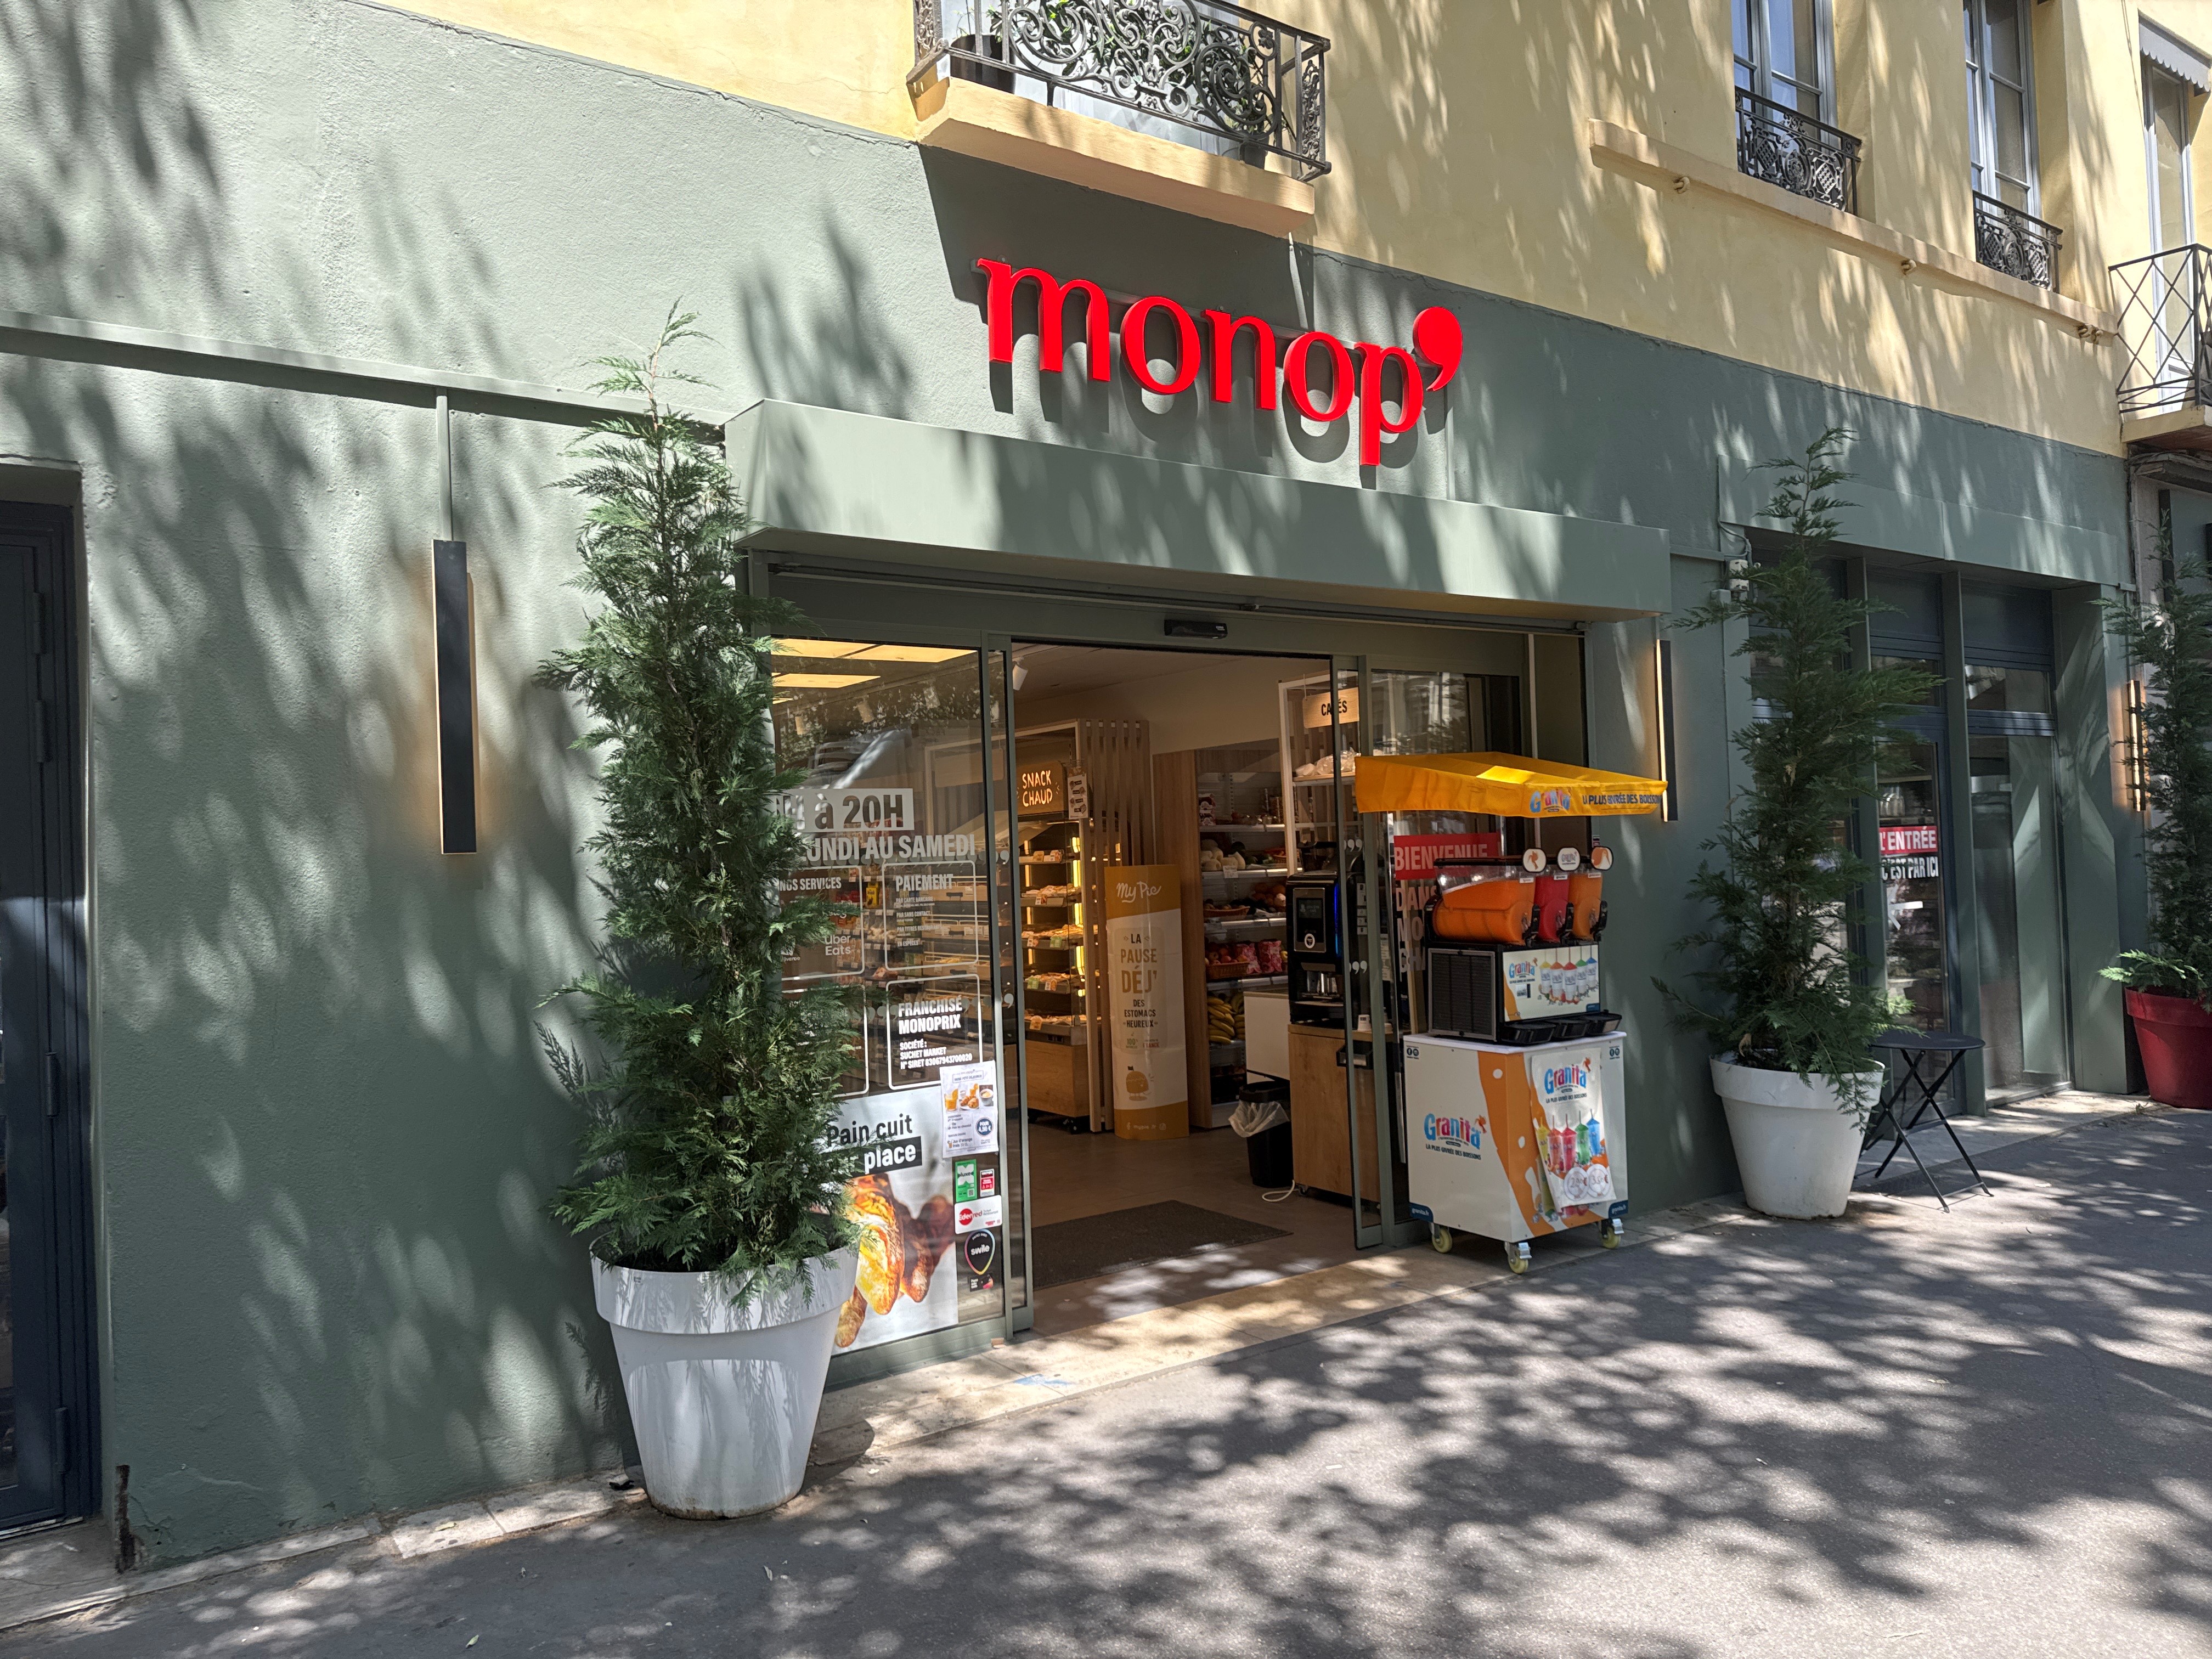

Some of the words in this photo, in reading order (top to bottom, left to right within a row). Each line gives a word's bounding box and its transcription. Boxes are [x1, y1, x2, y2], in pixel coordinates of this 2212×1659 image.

[977, 258, 1463, 466] monop'
[1321, 698, 1347, 716] CAÉS
[1022, 770, 1052, 789] SNACK
[1023, 788, 1053, 807] CHAUD
[1588, 794, 1607, 805] PLUS
[1626, 794, 1638, 804] DES
[815, 793, 834, 830] à
[842, 794, 904, 829] 20H
[1879, 825, 1937, 851] L'ENTRÉE
[795, 836, 860, 862] UNDI
[865, 835, 894, 860] AU
[899, 834, 975, 860] SAMEDI
[1881, 858, 1906, 881] C'EST
[1908, 857, 1926, 879] PAR
[1926, 856, 1939, 877] ICI
[800, 877, 842, 890] SERVICES
[895, 873, 954, 892] PAIEMENT
[1116, 882, 1137, 903] My
[1136, 881, 1162, 899] Pie
[824, 934, 851, 945] Uber
[1131, 933, 1142, 944] LA
[825, 945, 851, 956] Eats
[1120, 948, 1158, 964] PAUSE
[1509, 961, 1535, 978] Granita
[1121, 964, 1158, 994] DÉJ'
[898, 995, 963, 1017] FRANCHISÉ
[1133, 999, 1145, 1007] DES
[1124, 1009, 1156, 1018] ESTOMACS
[898, 1014, 961, 1035] MONOPRIX
[1126, 1019, 1154, 1028] HEUREUX
[900, 1039, 924, 1051] SOCIÉTÉ
[900, 1049, 923, 1060] SUCHET
[923, 1046, 947, 1057] MARKET
[908, 1059, 925, 1069] SIRET
[1544, 1064, 1587, 1094] Granita
[827, 1120, 870, 1147] Pain
[876, 1113, 913, 1139] cuit
[1424, 1113, 1481, 1150] Granita
[864, 1144, 916, 1175] place
[960, 1210, 983, 1221] Edenred
[970, 1244, 990, 1256] swile
